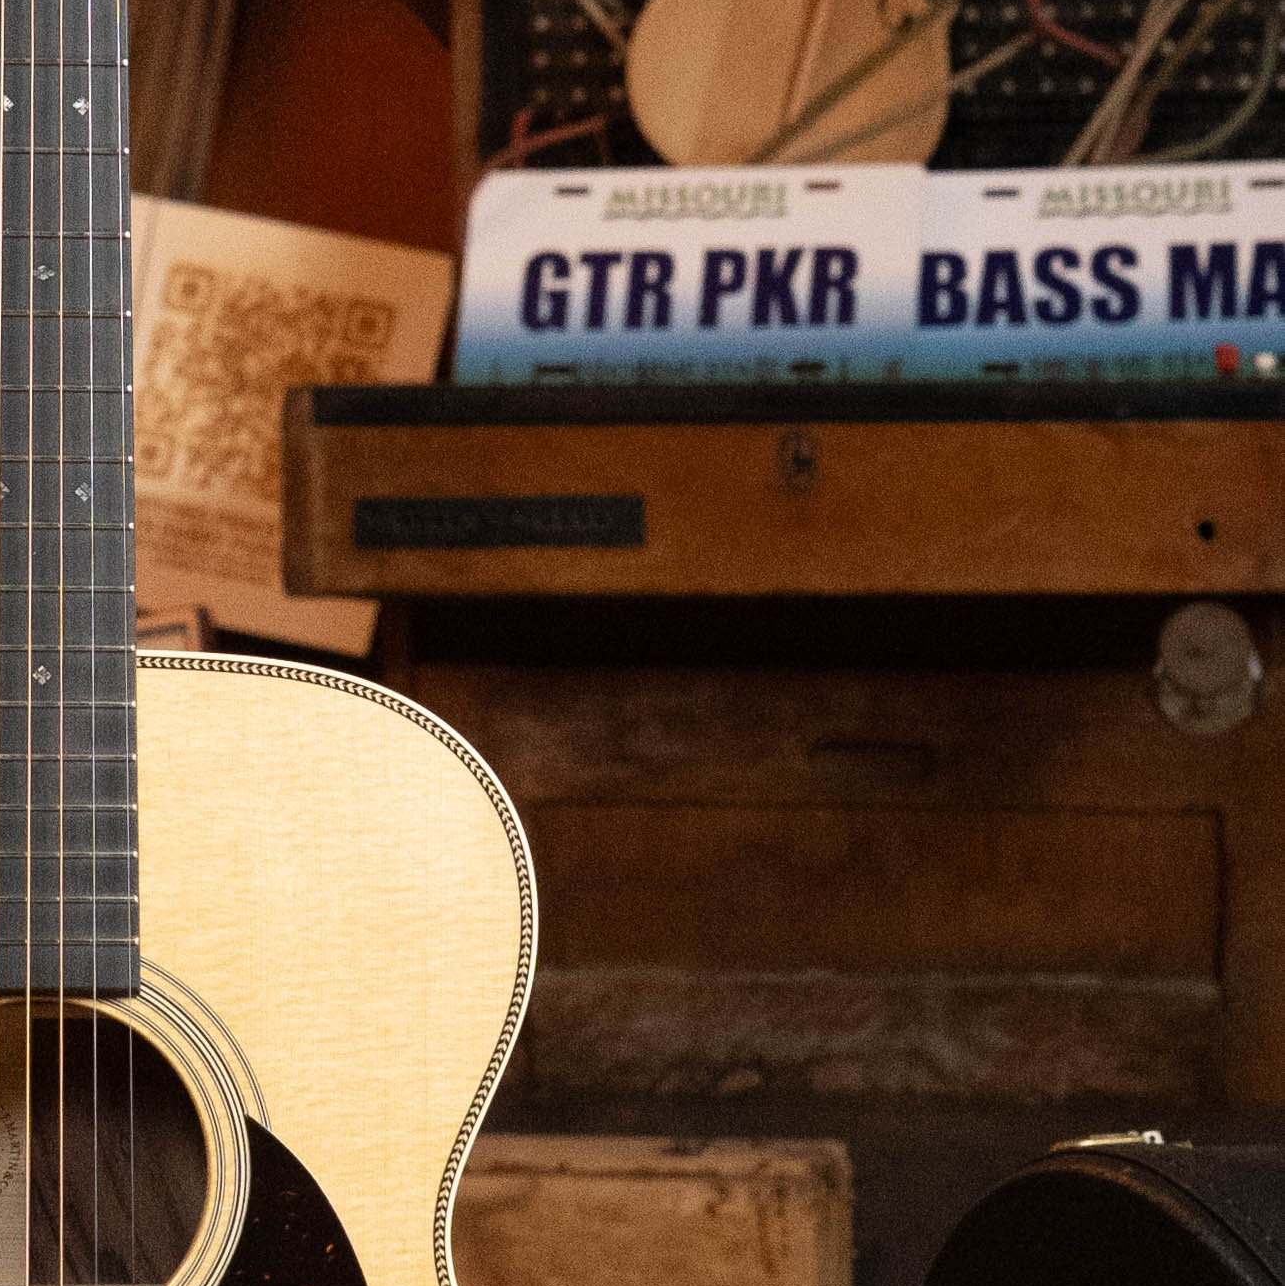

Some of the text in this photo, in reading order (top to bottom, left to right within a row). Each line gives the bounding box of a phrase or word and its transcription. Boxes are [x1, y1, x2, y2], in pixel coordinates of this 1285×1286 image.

[606, 180, 789, 217] MISSOURI
[1039, 177, 1232, 215] MISSOURI
[519, 244, 860, 332] GTR PKR
[916, 242, 1141, 328] BASS
